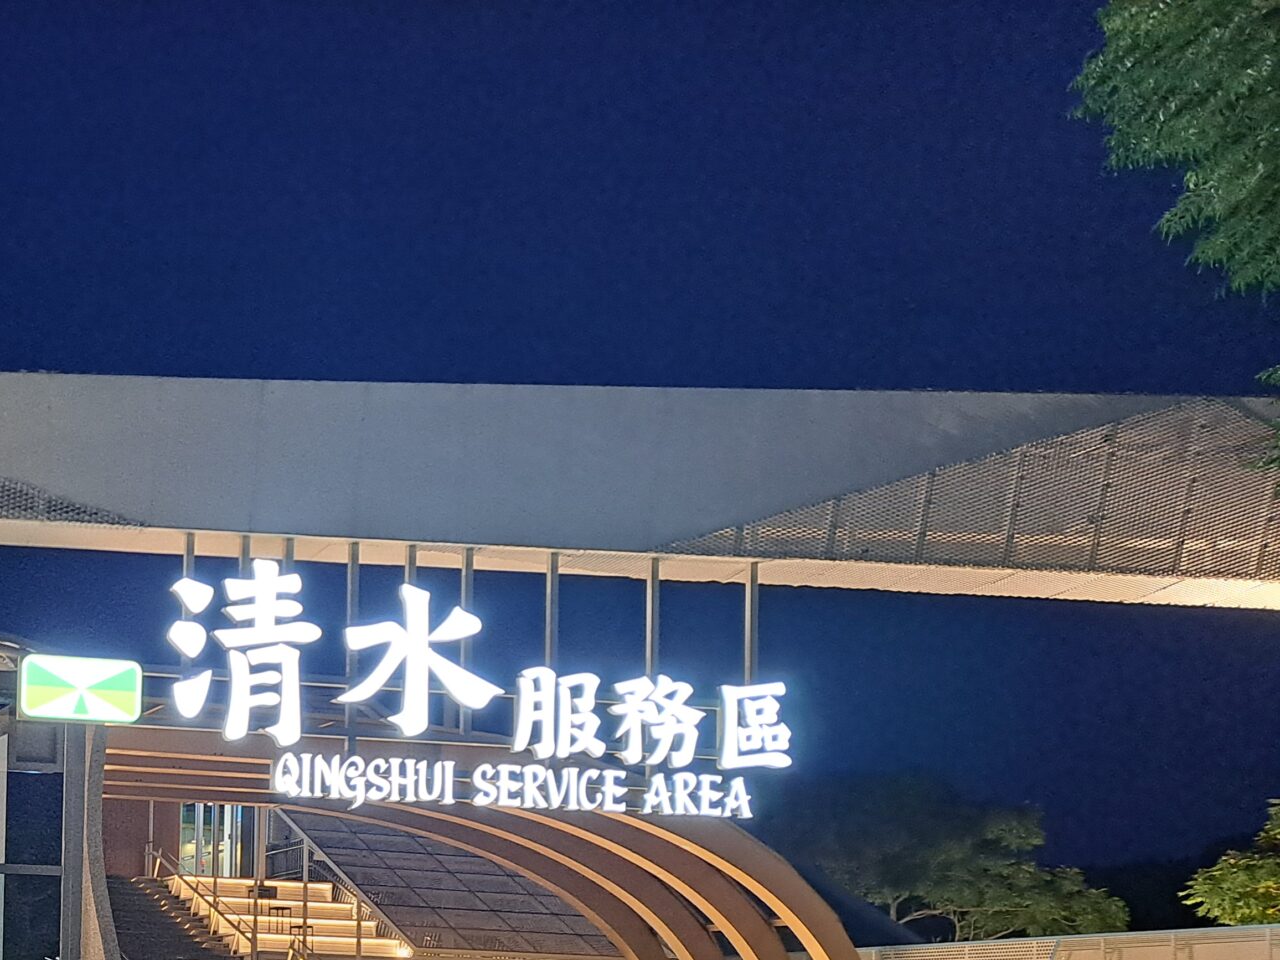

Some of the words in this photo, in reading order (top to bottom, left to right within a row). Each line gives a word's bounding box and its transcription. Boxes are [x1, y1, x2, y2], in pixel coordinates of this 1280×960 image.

[273, 751, 456, 812] QINGSHUI
[471, 762, 629, 816] SERVICE
[642, 771, 754, 821] AREA
